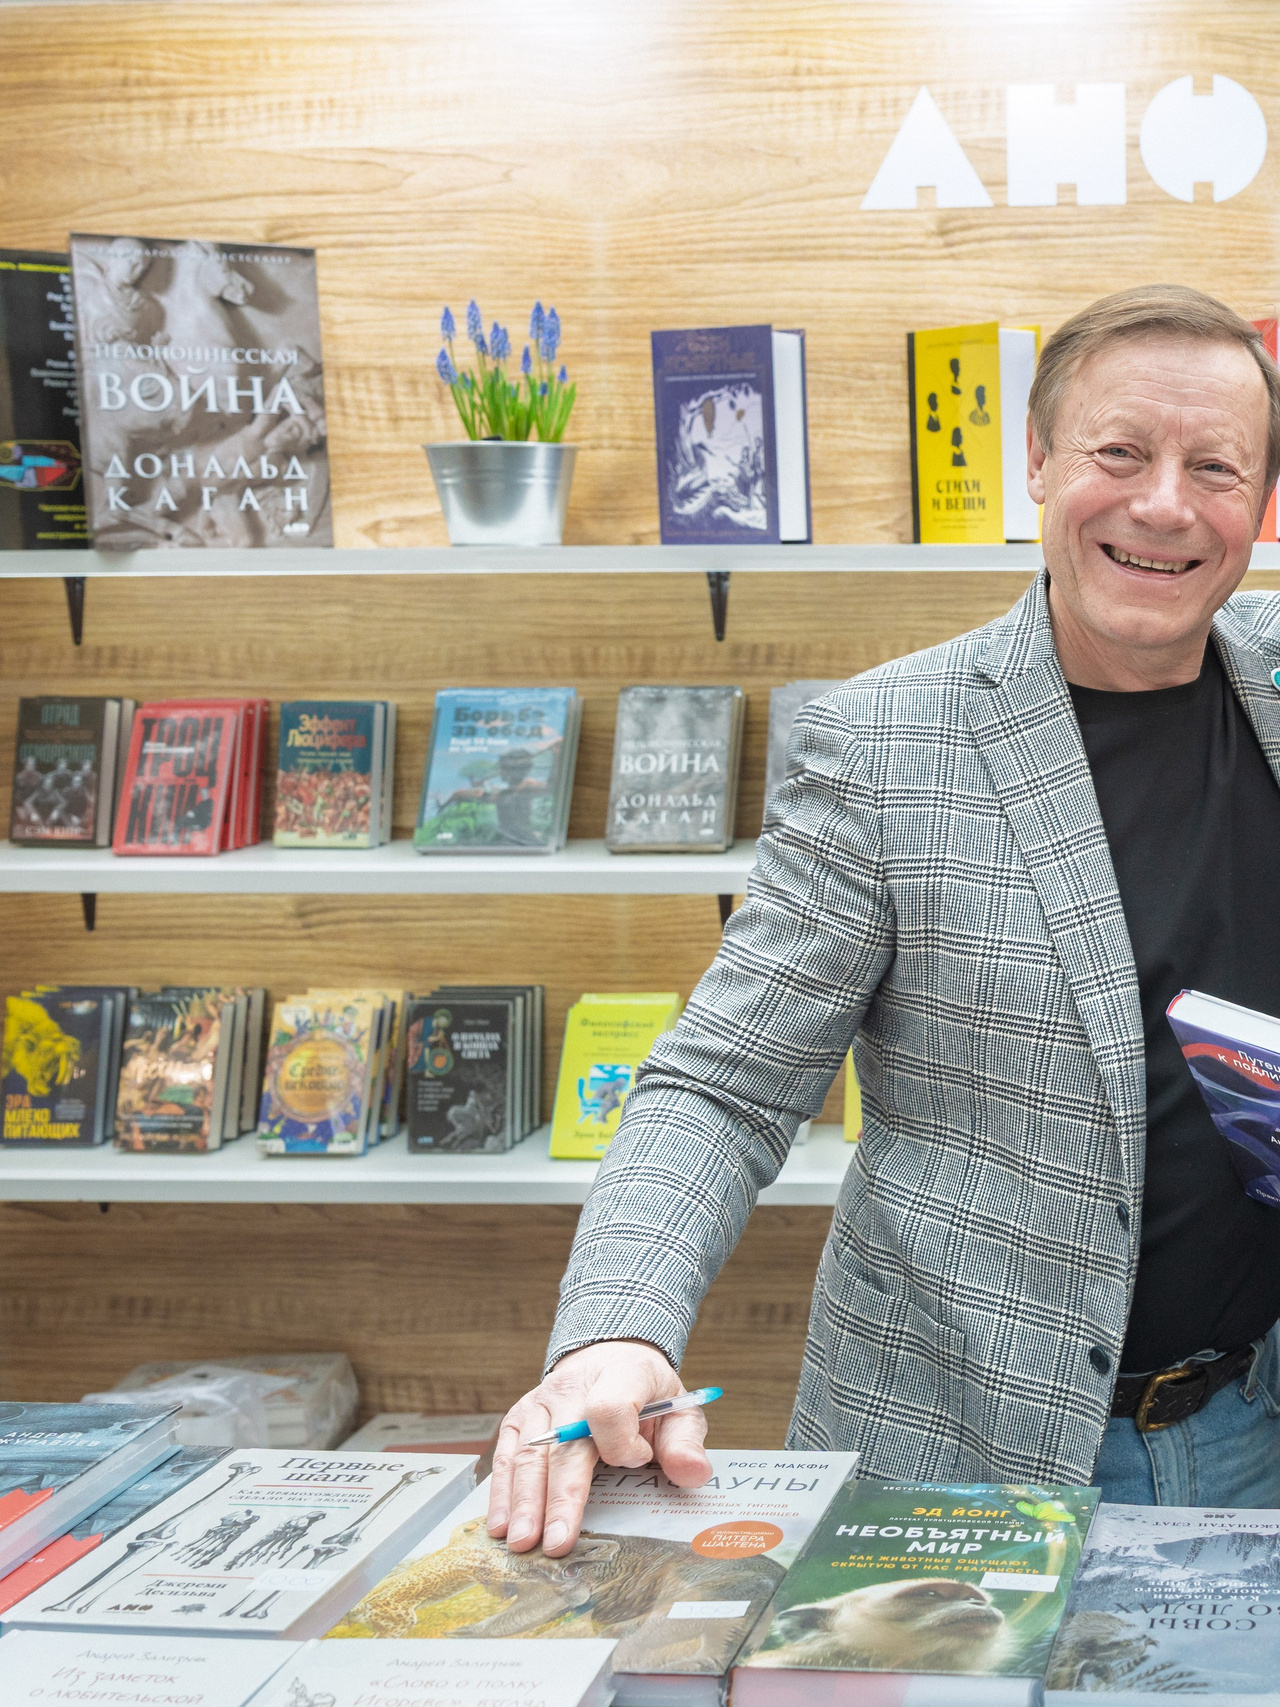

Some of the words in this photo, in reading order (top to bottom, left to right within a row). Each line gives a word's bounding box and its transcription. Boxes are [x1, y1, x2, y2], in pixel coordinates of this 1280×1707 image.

[95, 343, 300, 366] ПЕЛОПОННЕССКАЯ
[96, 364, 308, 415] ВОЙНА
[104, 452, 309, 480] ДОНАЛЬД
[936, 479, 982, 494] СТИХИ
[107, 485, 309, 512] КАГАН
[932, 497, 941, 511] И
[945, 496, 987, 511] ВЕЩИ
[619, 749, 720, 774] ВОЙНА
[615, 793, 717, 809] ДОНАЛЬД
[614, 809, 716, 825] КАГАН
[278, 1457, 405, 1473] Первые
[728, 1461, 769, 1469] РОСС
[773, 1462, 830, 1471] МАКФИ
[282, 1472, 370, 1484] шаги
[267, 1490, 374, 1499] ПРЯМОХОЖДЕНИЕ
[601, 1500, 664, 1508] МАМОНТОВ,
[668, 1501, 742, 1509] САБЛЕЗУБЫХ
[911, 1507, 943, 1518] ЭД
[951, 1506, 1011, 1518] ЙОНГ
[712, 1535, 765, 1543] ПИТЕРА
[835, 1524, 1066, 1544] НЕОБЪЯТНЫЙ
[701, 1541, 768, 1549] ШАУТЕНА
[905, 1541, 983, 1555] МИР
[830, 1561, 896, 1570] СКРЫТУЮ
[954, 1566, 1041, 1575] РЕАЛЬНОСТЬ
[878, 1556, 952, 1564] ЖИВОТНЫЕ
[957, 1558, 1030, 1567] ОЩУЩАЮТ
[146, 1579, 228, 1590] Джереми
[135, 1587, 217, 1598] Десильва
[1229, 1594, 1261, 1602] КАК
[1112, 1601, 1234, 1615] ЛЬДАХ
[1147, 1617, 1257, 1631] СОВЫ
